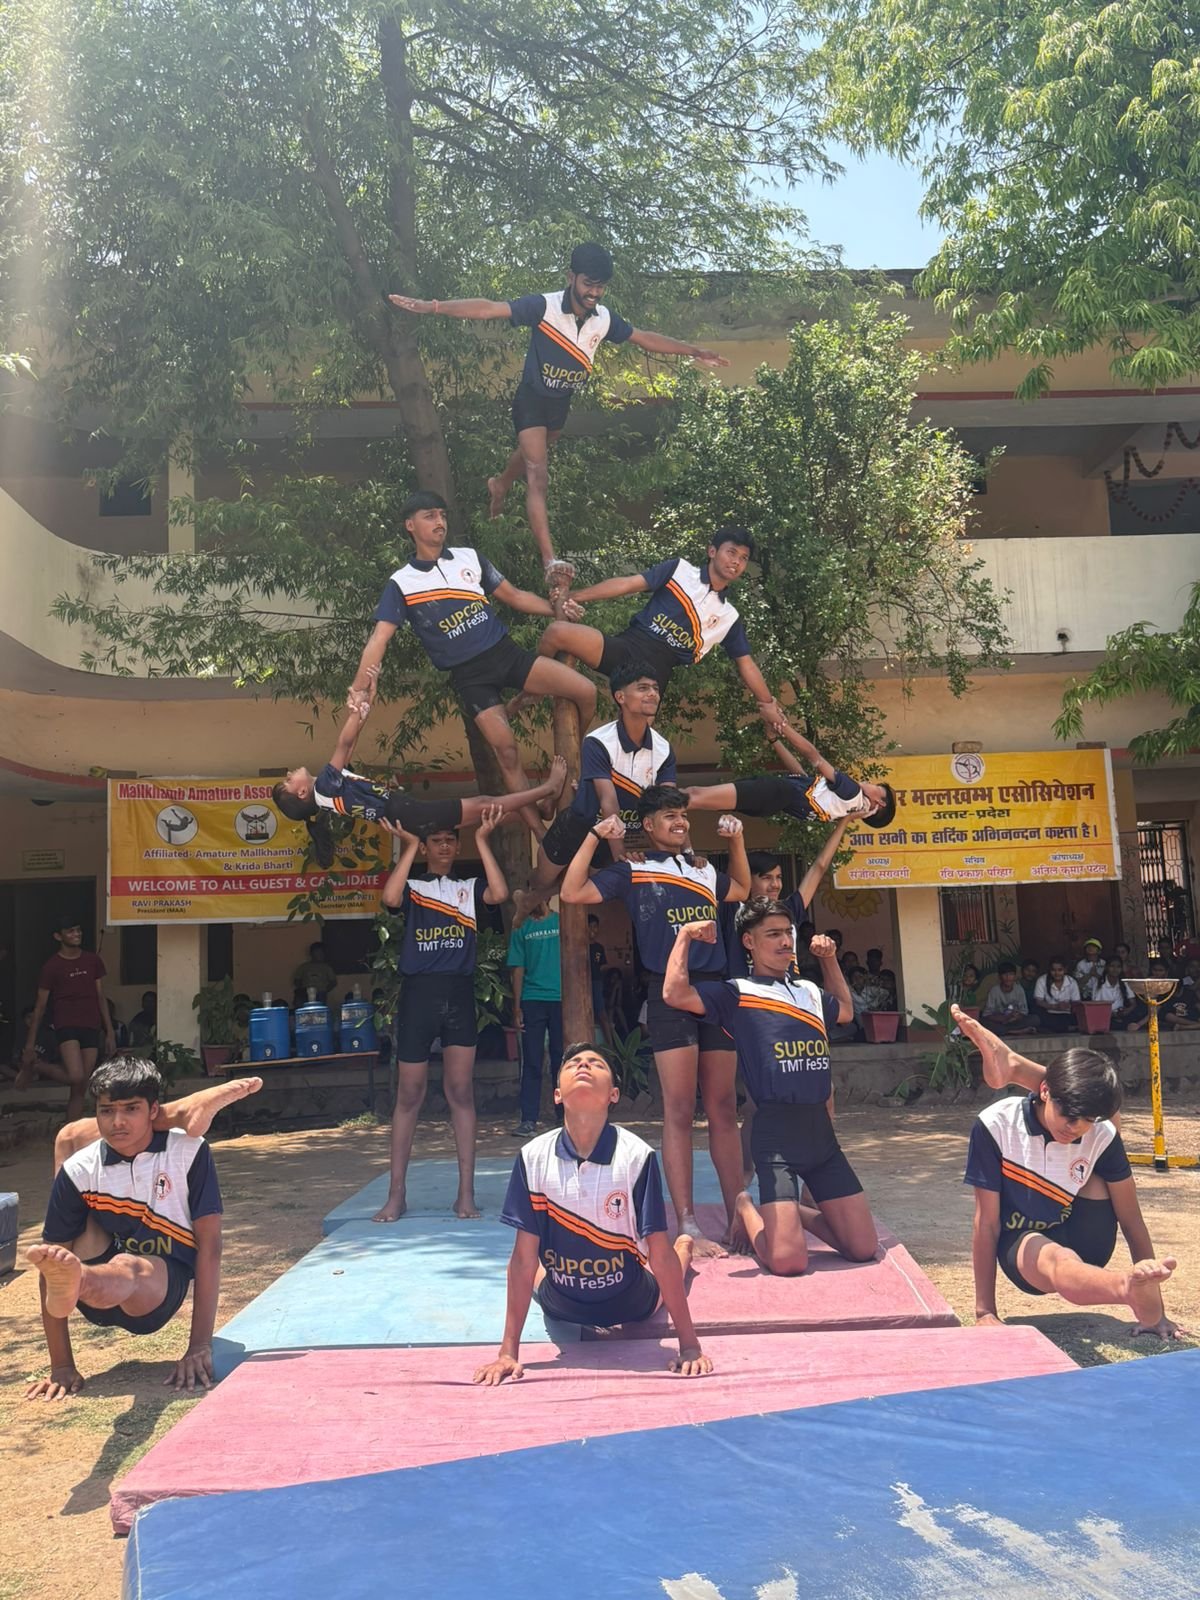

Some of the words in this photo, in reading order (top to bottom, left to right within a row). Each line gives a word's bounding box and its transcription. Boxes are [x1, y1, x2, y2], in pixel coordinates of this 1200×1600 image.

[438, 600, 484, 633] SUPCON
[447, 622, 467, 640] TMT
[466, 611, 488, 630] Fe550
[653, 613, 695, 649] SUPCON
[188, 787, 241, 801] Amature
[244, 785, 272, 799] Asso
[998, 779, 1095, 803] एसोसियेशन
[850, 833, 874, 846] आप
[879, 829, 907, 844] सभी
[911, 831, 927, 844] का
[931, 827, 968, 843] हार्दिक
[972, 826, 1041, 842] अभिनन्दन
[1045, 826, 1077, 839] करता
[196, 850, 237, 858] Amature
[240, 847, 294, 858] Mallkhamb
[223, 862, 232, 871] &
[235, 862, 261, 871] Krida
[264, 861, 293, 870] Bharti
[128, 880, 196, 892] WELCOME
[200, 879, 218, 891] TO
[222, 879, 246, 890] ALL
[249, 878, 291, 890] GUEST
[295, 877, 306, 888] &
[667, 905, 717, 923] SUPCON
[417, 941, 438, 952] TMT
[774, 1039, 830, 1059] SUPCON
[779, 1058, 804, 1073] TMT
[544, 1249, 625, 1277] SUPCON
[580, 1271, 624, 1290] Fe550
